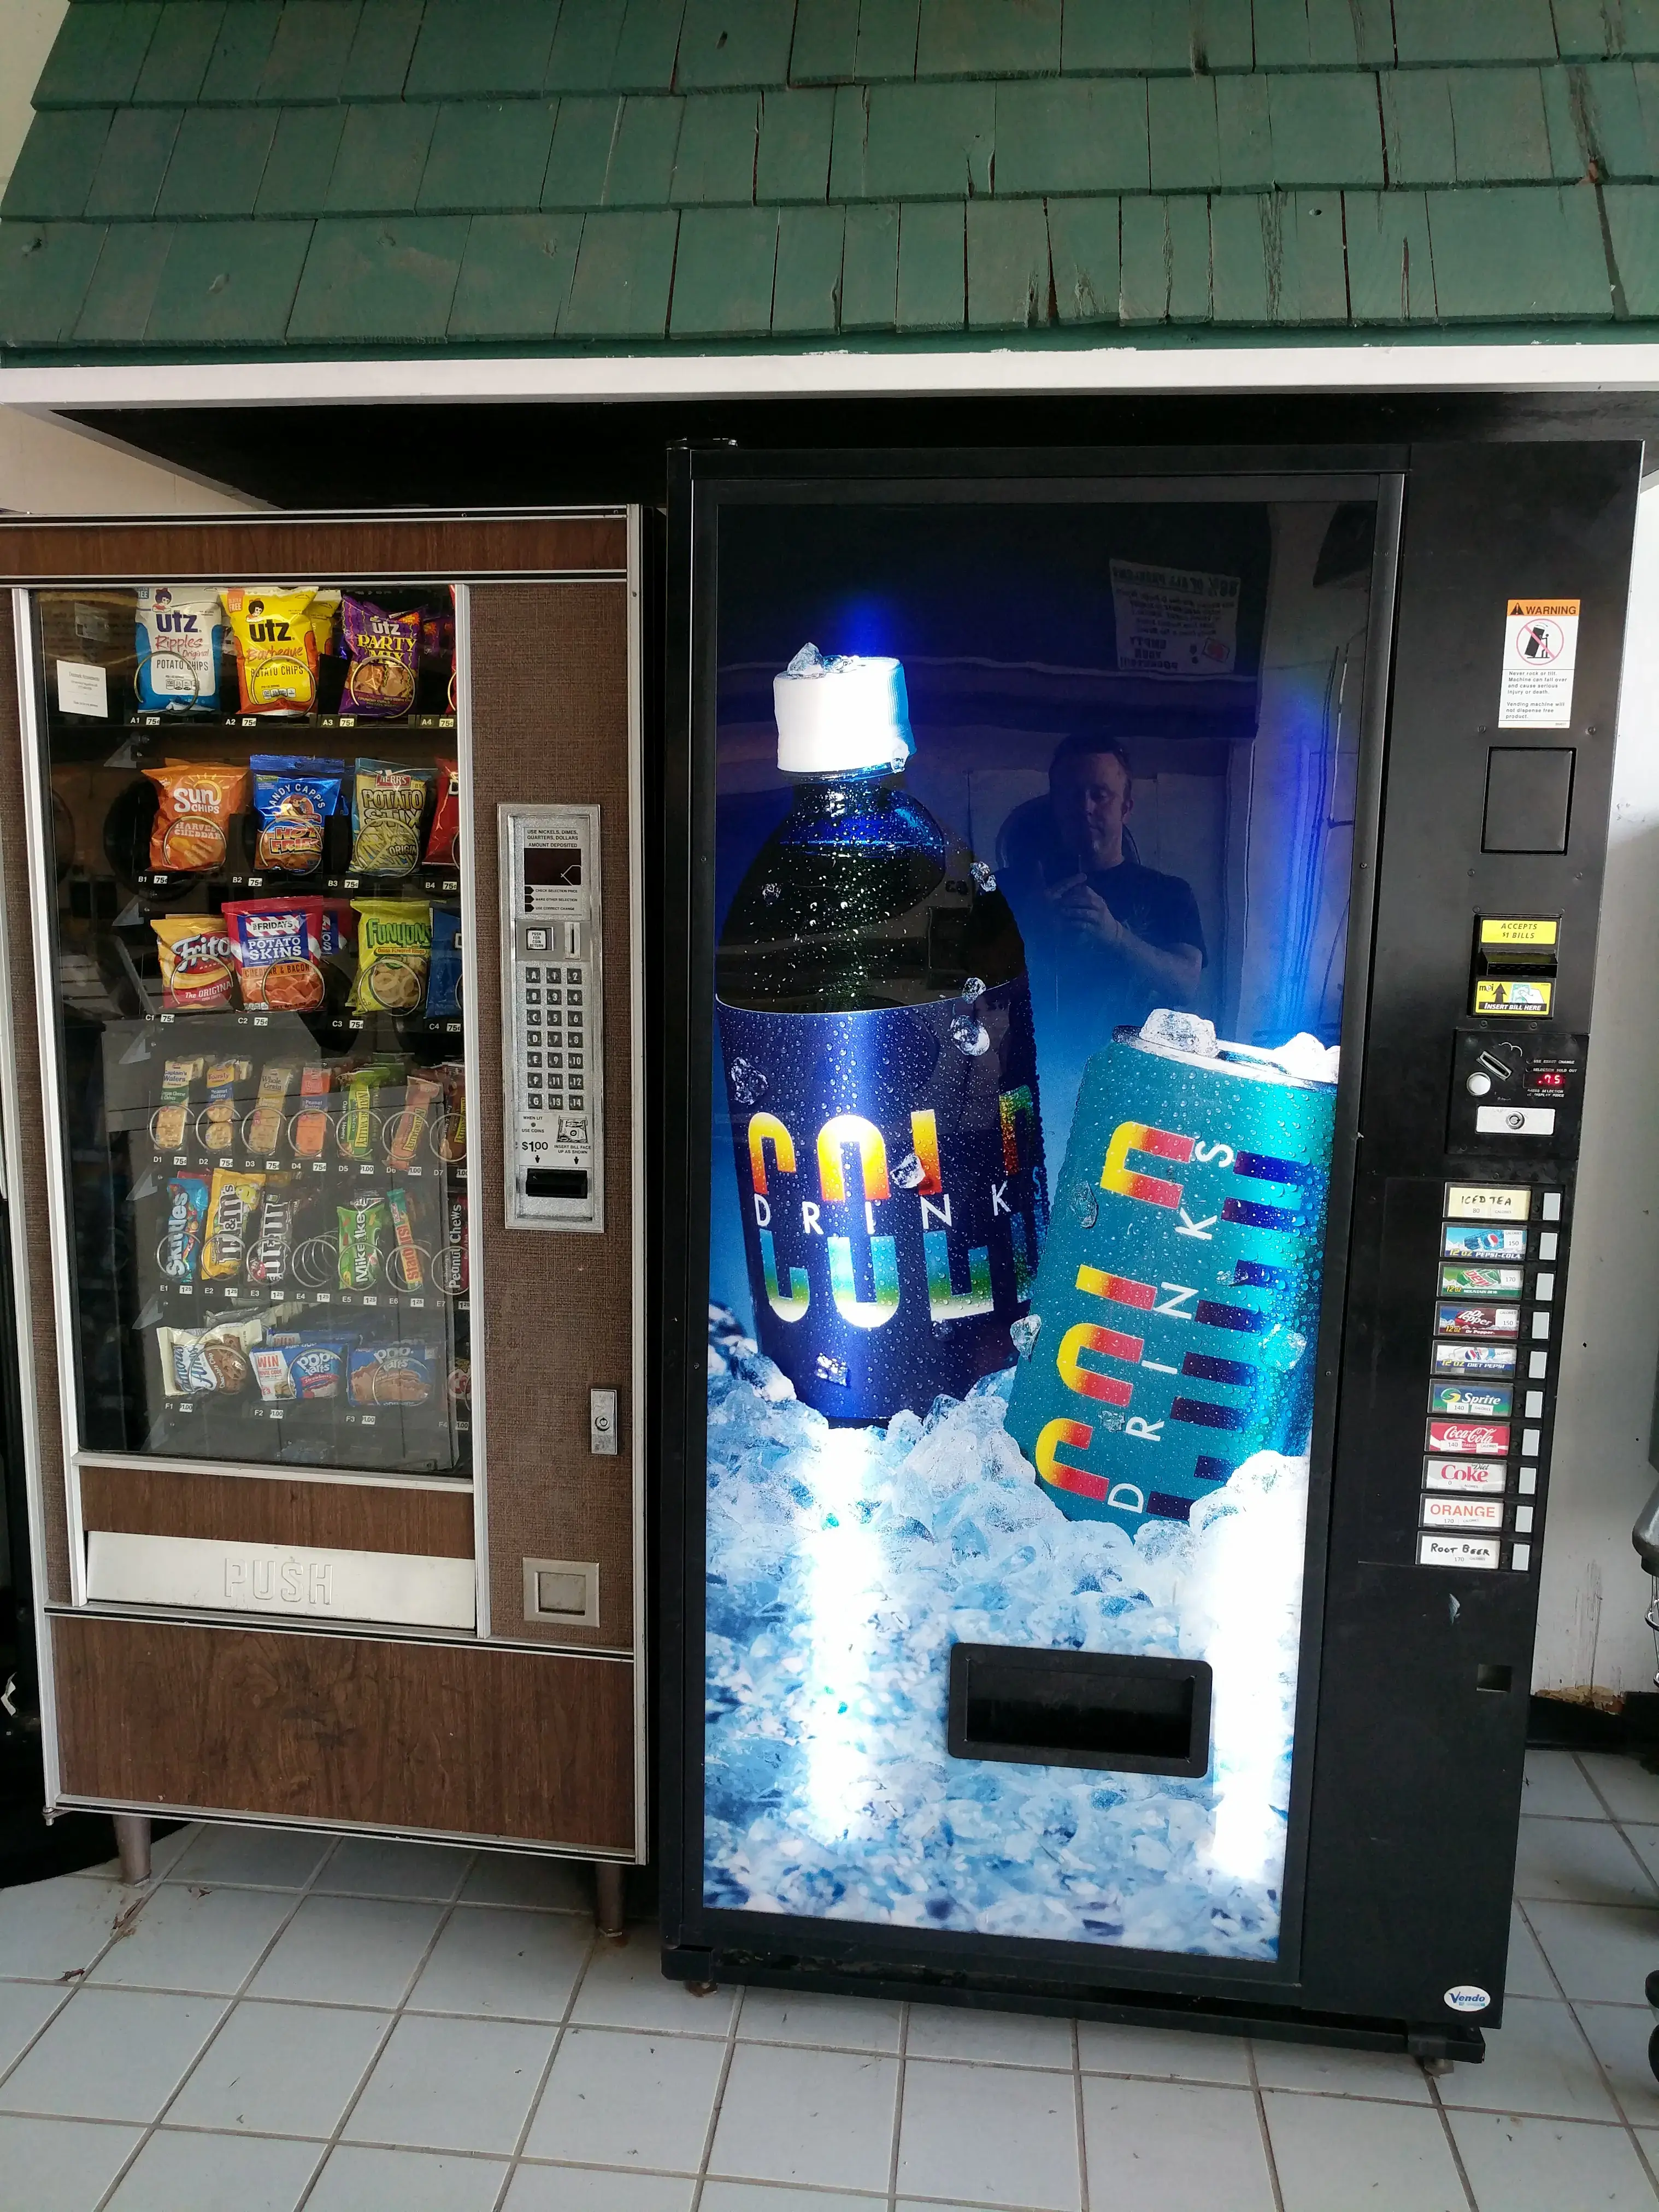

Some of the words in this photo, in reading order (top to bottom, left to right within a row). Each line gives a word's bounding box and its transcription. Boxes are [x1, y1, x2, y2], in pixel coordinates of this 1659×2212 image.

[229, 603, 242, 611] FREE
[1526, 606, 1576, 615] WARNING
[156, 610, 198, 633] utz
[249, 619, 292, 642] utz
[155, 634, 203, 652] Ripples
[356, 634, 417, 652] PARTY
[183, 649, 209, 660] Original
[246, 646, 303, 662] Barbeque
[156, 660, 184, 670] POTATO
[281, 666, 303, 675] CHIPS
[380, 775, 408, 785] HERR'S
[173, 787, 221, 813] Sun
[269, 784, 291, 806] ANDY
[295, 784, 326, 809] CAPP'S
[362, 789, 424, 809] POTATO
[191, 804, 220, 814] CHIPS
[364, 808, 422, 828] STIX
[275, 826, 320, 840] HOT
[270, 838, 322, 854] FRIES
[257, 920, 293, 930] FRIDAYS
[248, 937, 301, 950] POTATO
[170, 934, 231, 972] Frito
[249, 946, 302, 961] SKINS
[287, 963, 310, 973] BACON
[1479, 984, 1493, 992] mei
[573, 1056, 581, 1065] 10
[262, 1076, 281, 1084] Whole
[552, 1077, 560, 1085] 11
[573, 1078, 581, 1086] 12
[552, 1098, 561, 1106] 13
[573, 1098, 581, 1107] 14
[522, 1141, 548, 1152] $1.00
[1461, 1196, 1486, 1204] ICED
[1489, 1197, 1511, 1206] TEA
[450, 1204, 462, 1243] Chews
[355, 1245, 368, 1283] Mike
[449, 1248, 461, 1289] Peanut
[1457, 1311, 1492, 1326] Pepper
[1470, 1310, 1485, 1318] Dr
[1108, 1139, 1234, 1514] DRINKS
[258, 1355, 279, 1367] WIN
[305, 1375, 332, 1383] Strawberry
[1462, 1392, 1501, 1406] Sprite
[1444, 1426, 1497, 1443] Coca-Cola
[1441, 1464, 1489, 1482] Coke
[1430, 1504, 1495, 1517] ORANGE
[225, 1556, 332, 1605] PUSH
[1449, 1991, 1485, 2003] Vendo
